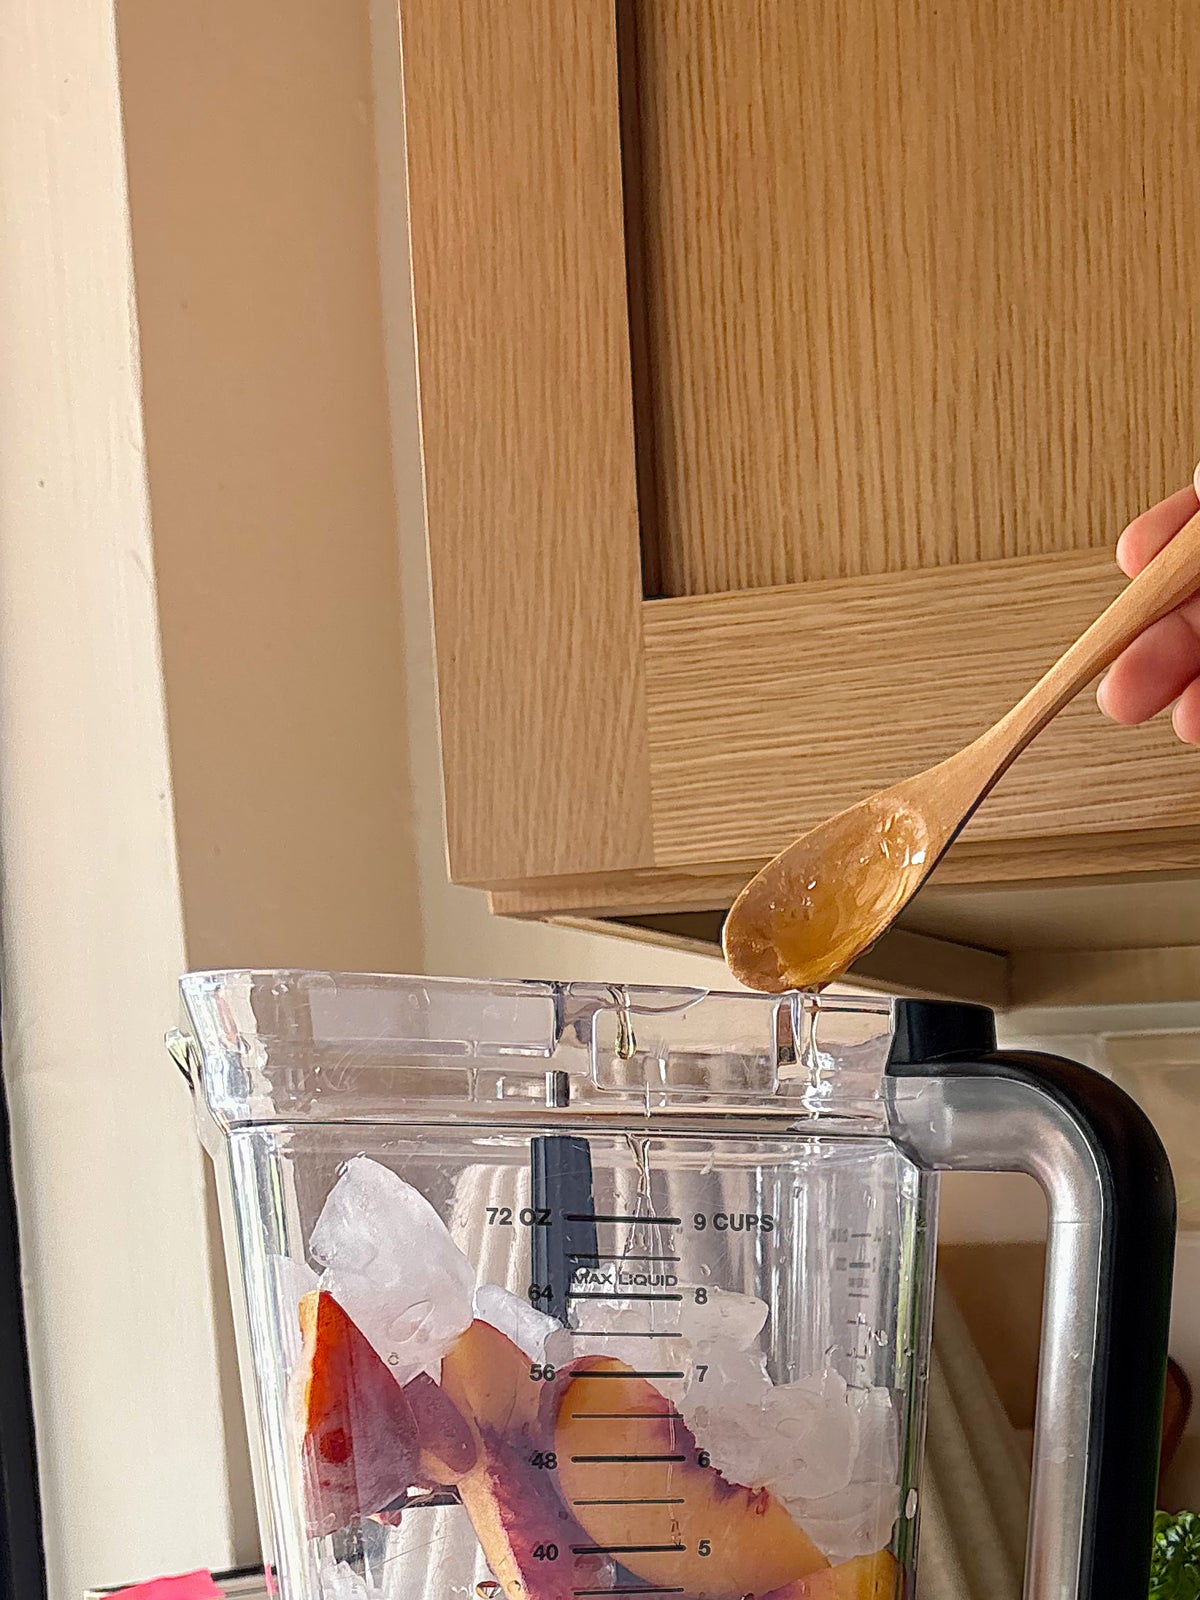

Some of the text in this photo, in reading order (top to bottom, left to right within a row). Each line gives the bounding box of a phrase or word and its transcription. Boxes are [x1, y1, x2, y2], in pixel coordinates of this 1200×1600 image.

[486, 1207, 553, 1226] 72 OZ
[693, 1212, 774, 1233] 9 CUPS
[571, 1272, 679, 1287] MAX LIQUID
[528, 1284, 554, 1302] 64
[694, 1287, 708, 1305] 8
[529, 1364, 556, 1382] 56
[695, 1365, 709, 1382] 7
[531, 1452, 558, 1470] 48
[697, 1451, 711, 1468] 6
[532, 1544, 559, 1561] 40
[697, 1540, 712, 1557] 5
